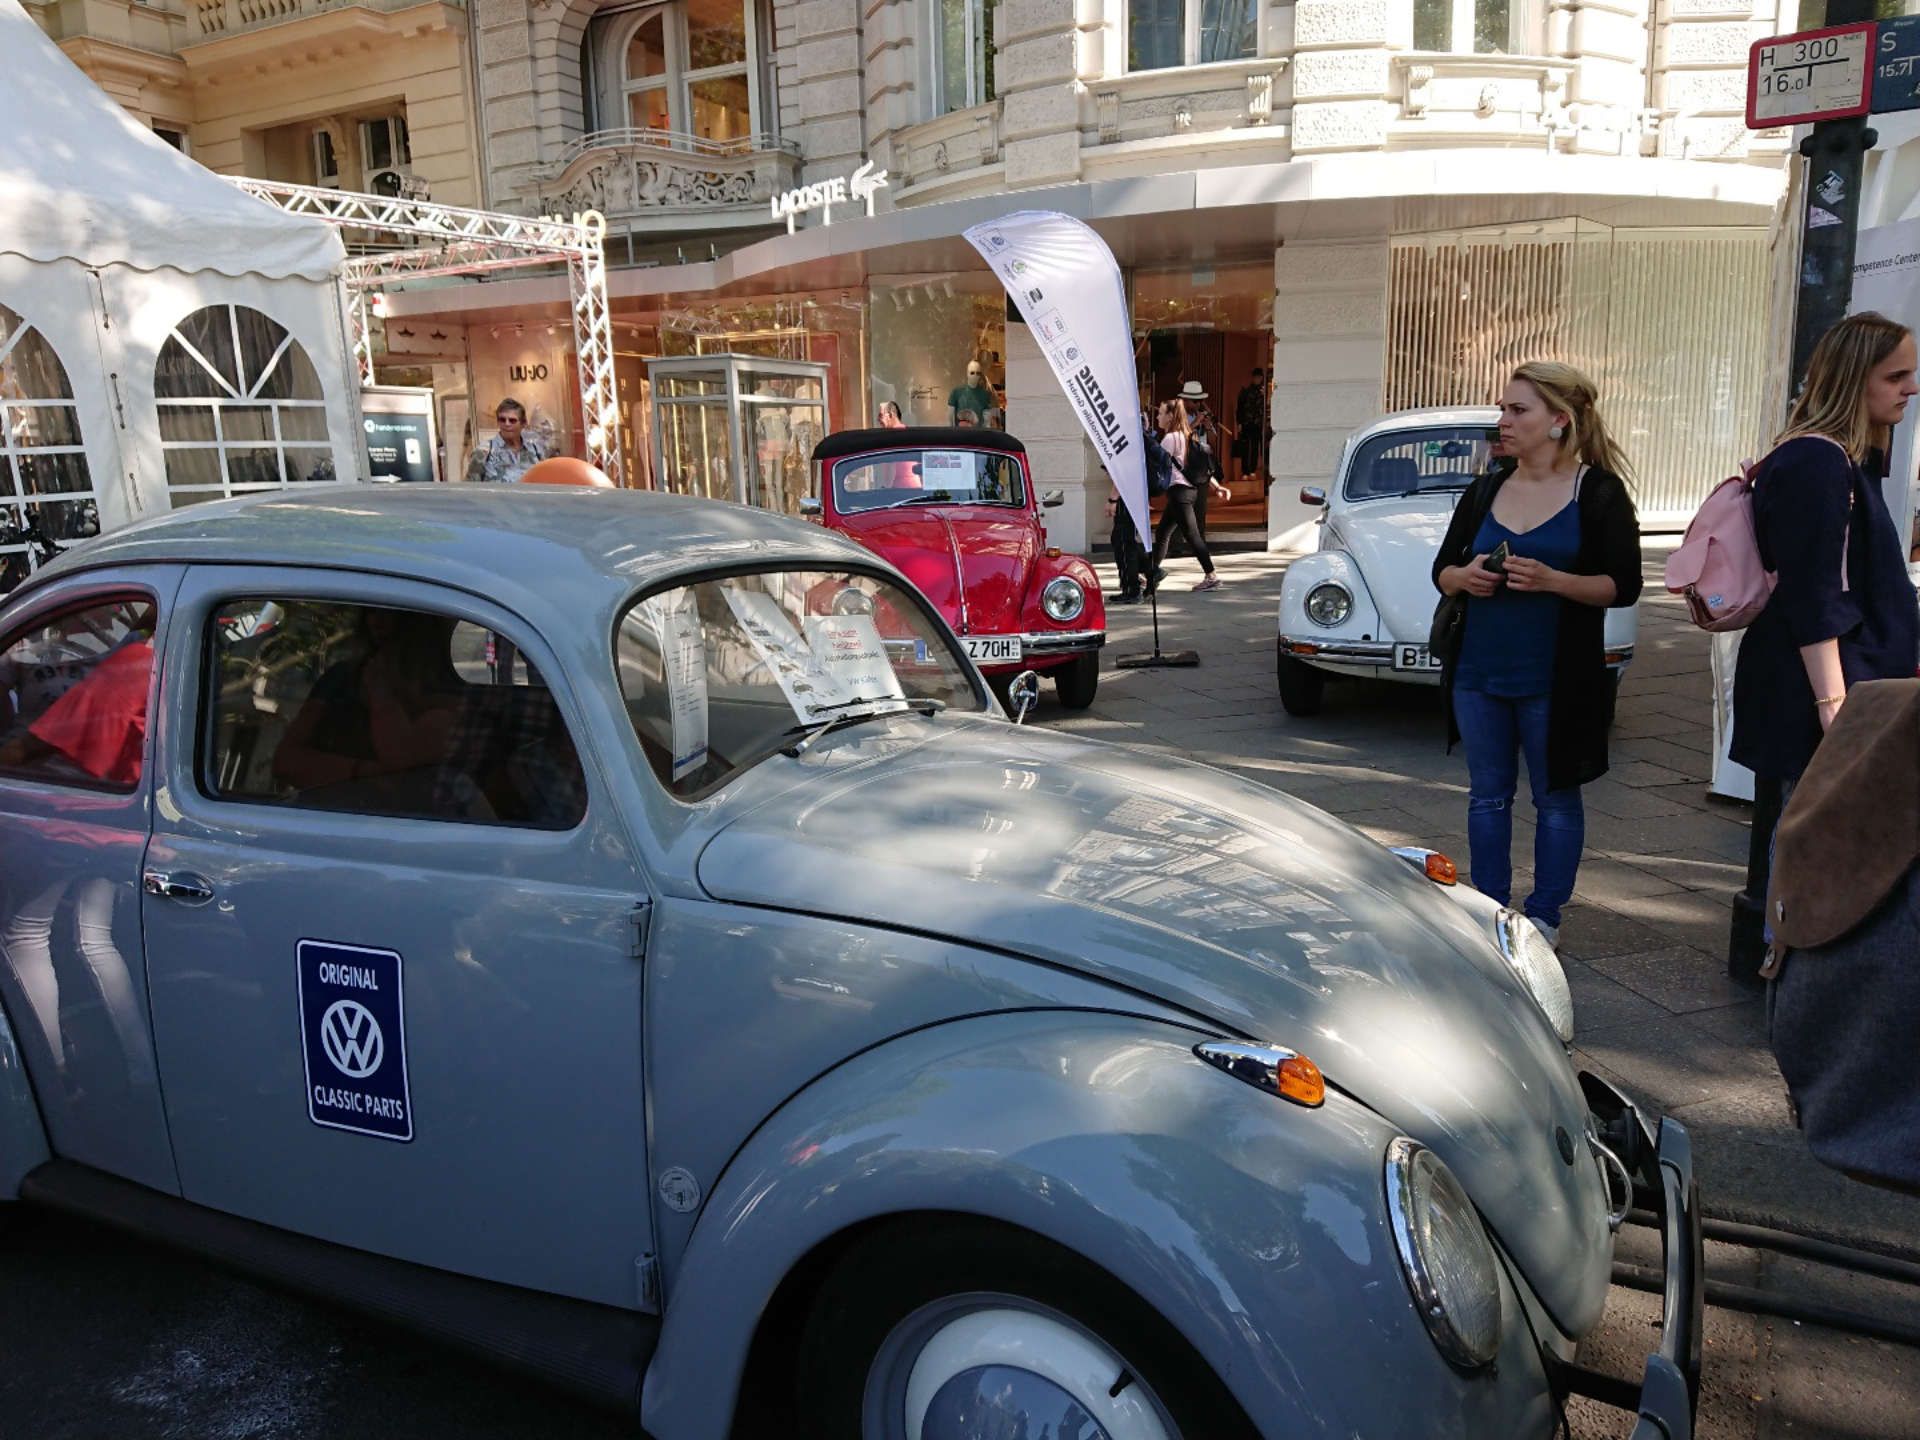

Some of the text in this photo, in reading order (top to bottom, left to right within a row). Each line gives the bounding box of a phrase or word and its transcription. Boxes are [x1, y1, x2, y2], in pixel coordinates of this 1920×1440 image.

[1760, 38, 1838, 67] H 300
[1881, 31, 1897, 52] S
[771, 176, 847, 219] LACOSTE
[1853, 258, 1893, 273] ompetence
[982, 640, 1010, 657] 70H
[319, 961, 379, 991] ORIGINAL
[314, 1084, 404, 1120] CLASSIC PARTS
